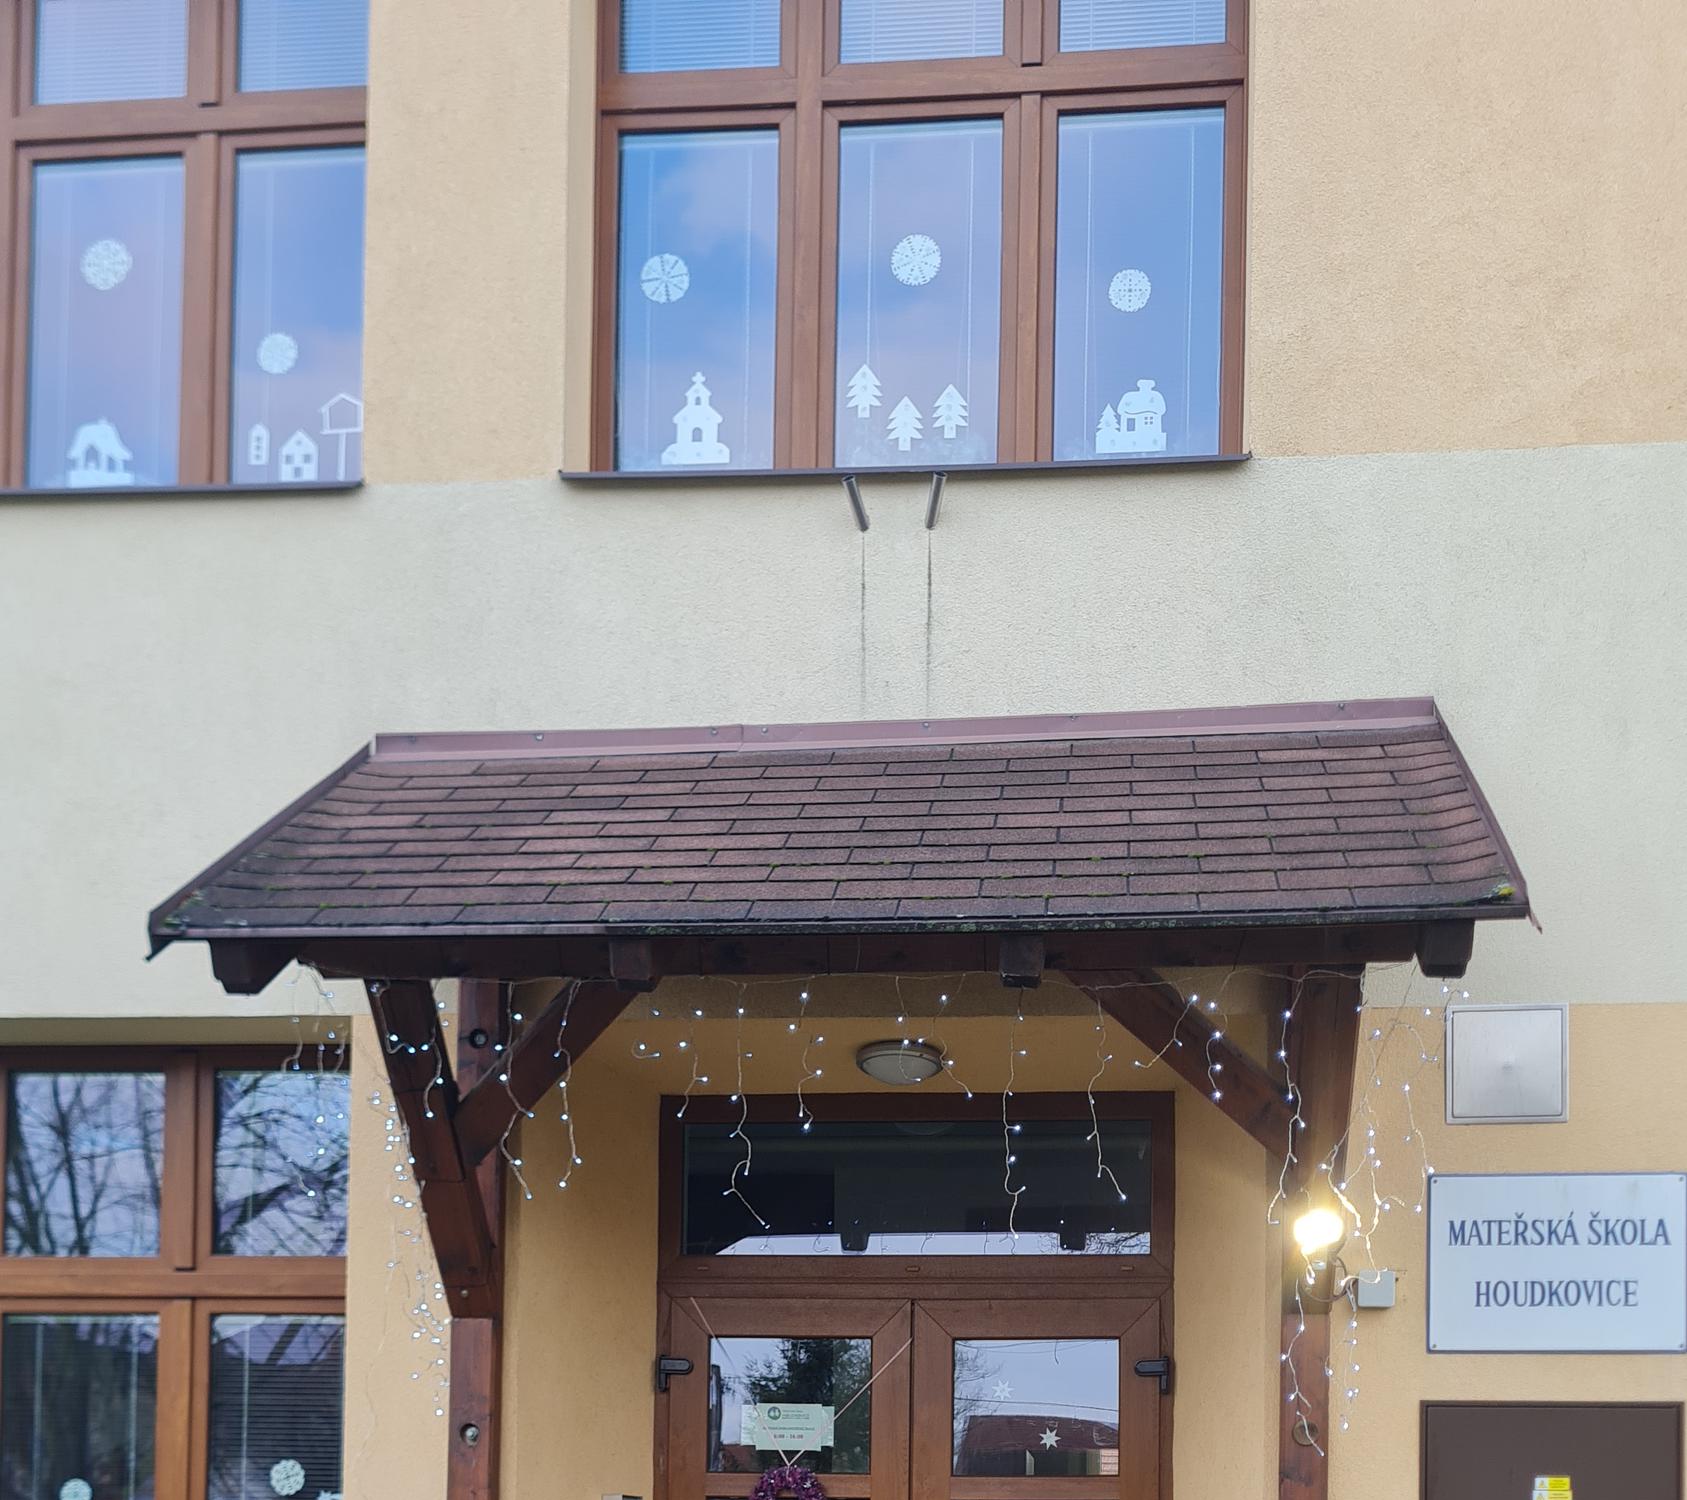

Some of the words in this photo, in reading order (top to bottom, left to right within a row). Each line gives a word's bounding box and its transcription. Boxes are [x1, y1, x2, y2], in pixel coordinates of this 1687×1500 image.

[1448, 1210, 1580, 1246] MATEŘSKÁ
[1587, 1210, 1671, 1246] ŠKOLA
[1474, 1280, 1638, 1307] HOUDKOVICE
